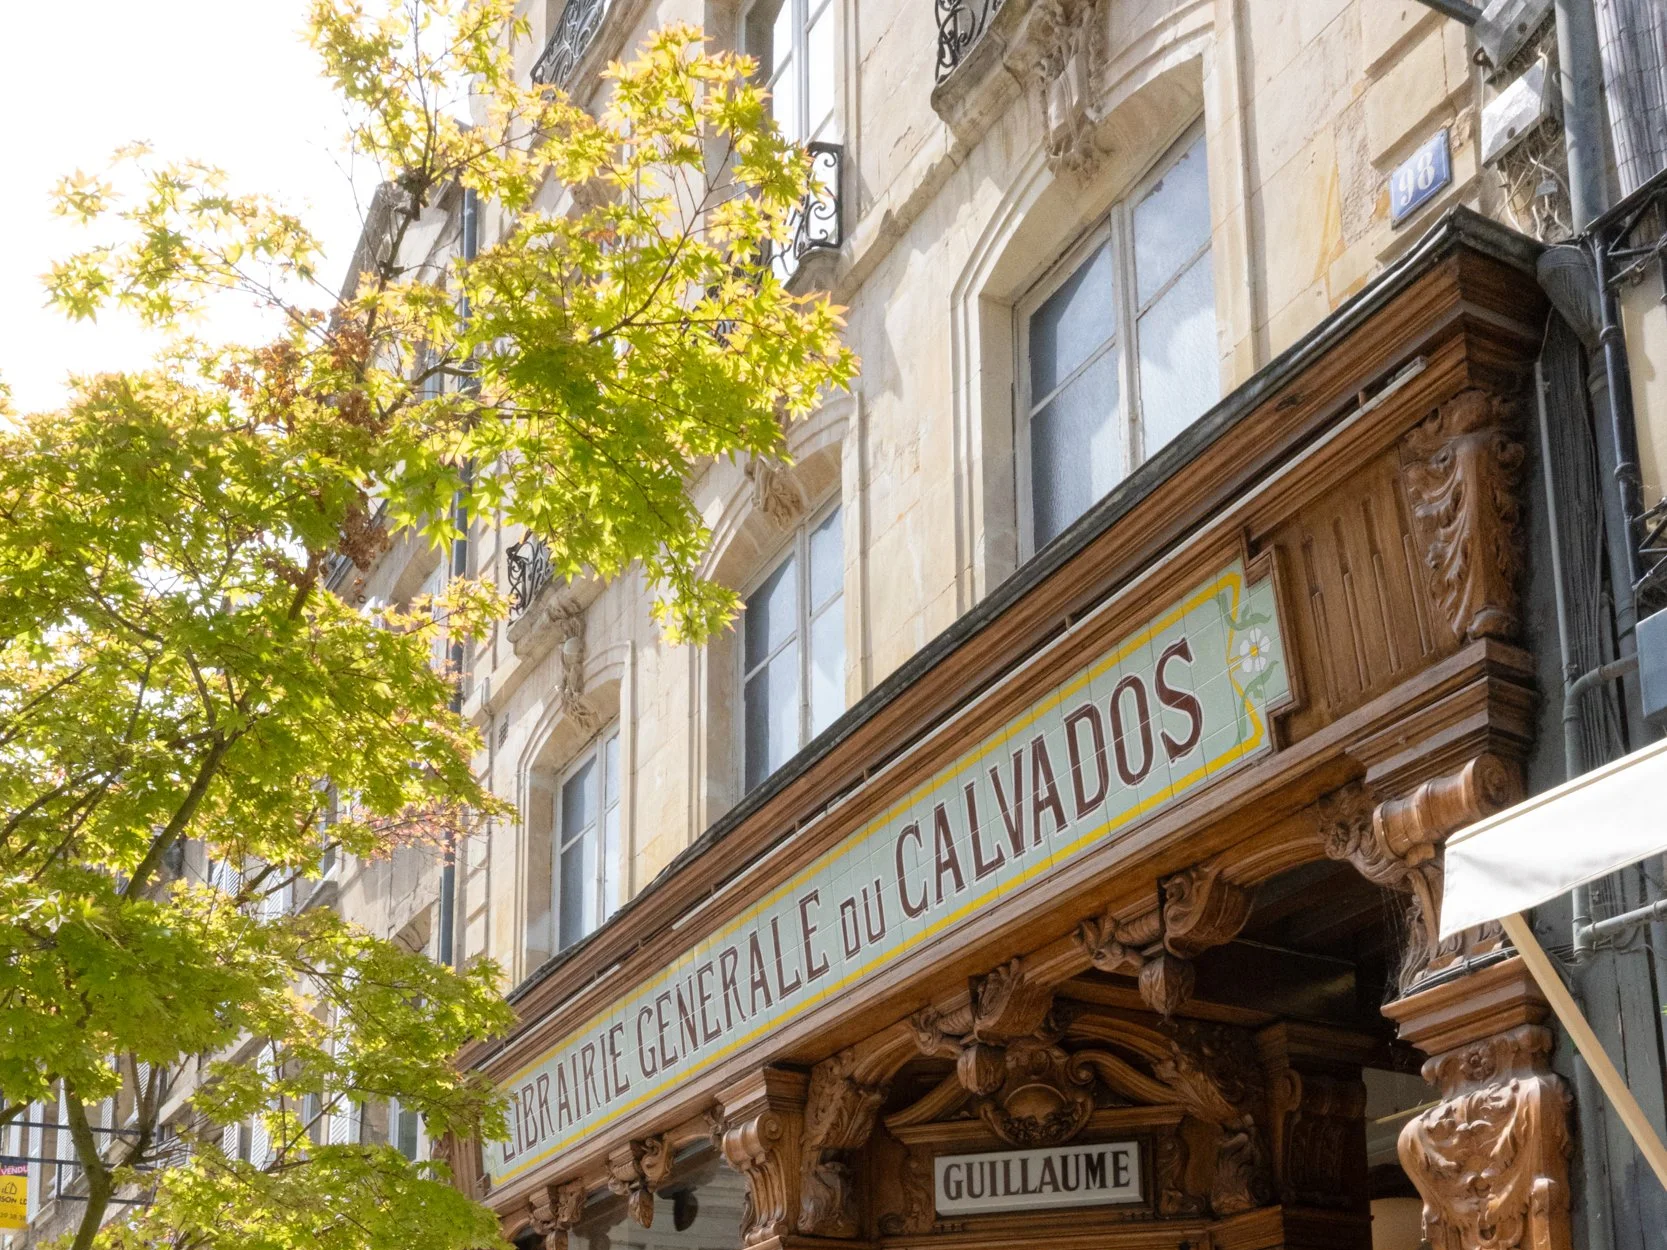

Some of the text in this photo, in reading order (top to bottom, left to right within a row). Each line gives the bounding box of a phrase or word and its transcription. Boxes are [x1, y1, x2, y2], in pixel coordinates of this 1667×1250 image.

[1398, 150, 1435, 205] 98
[635, 888, 830, 1080] GENERALE
[838, 878, 886, 961] DU
[895, 637, 1203, 920] CALVADOS
[943, 1150, 1131, 1200] GUILLAUME
